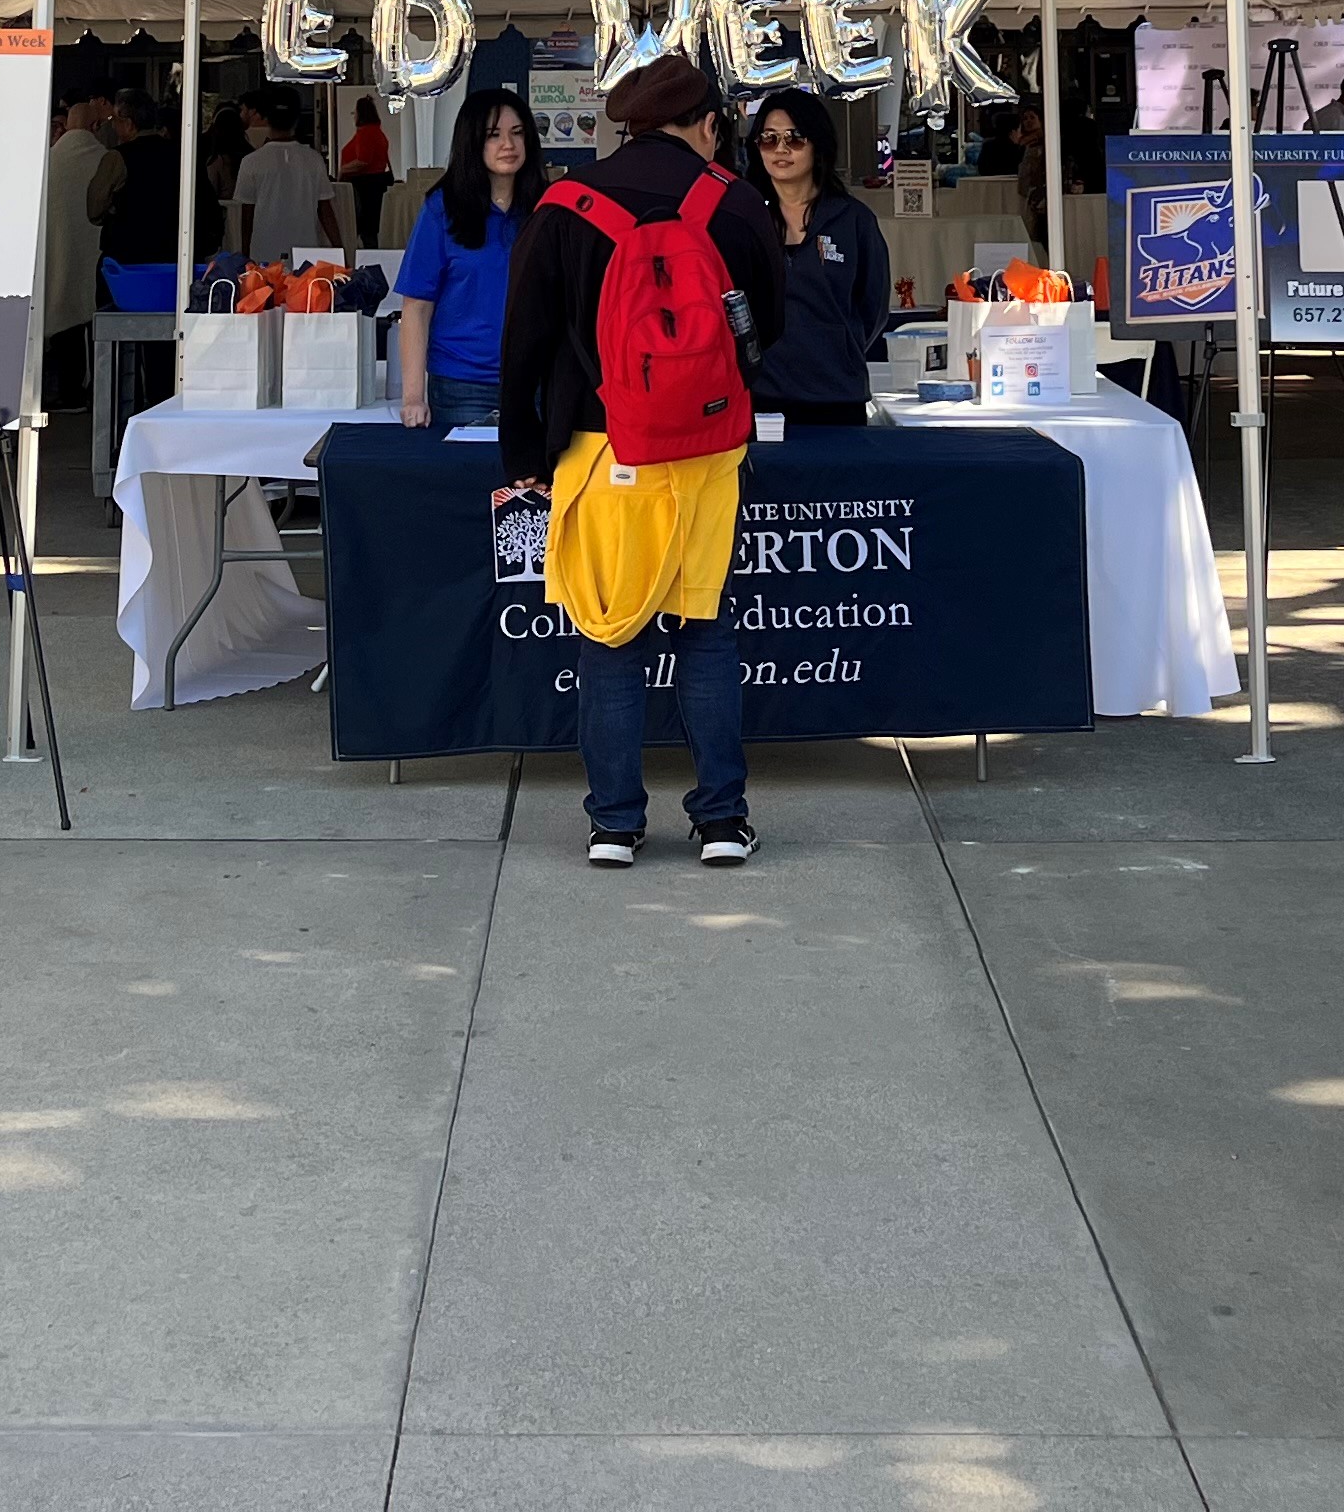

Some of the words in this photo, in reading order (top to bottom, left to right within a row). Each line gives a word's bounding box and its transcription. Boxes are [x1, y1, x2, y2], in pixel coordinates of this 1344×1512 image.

[6, 35, 47, 48] Week
[531, 85, 565, 95] STUDY
[533, 94, 576, 104] ABROAD
[1128, 150, 1202, 161] CALIFORNIA
[1205, 150, 1233, 161] STAT
[1254, 149, 1322, 162] NIVERSITY,
[1287, 281, 1344, 297] Future
[783, 499, 914, 521] UNIVERSITY
[733, 526, 914, 575] ERTON
[729, 593, 913, 630] ducation
